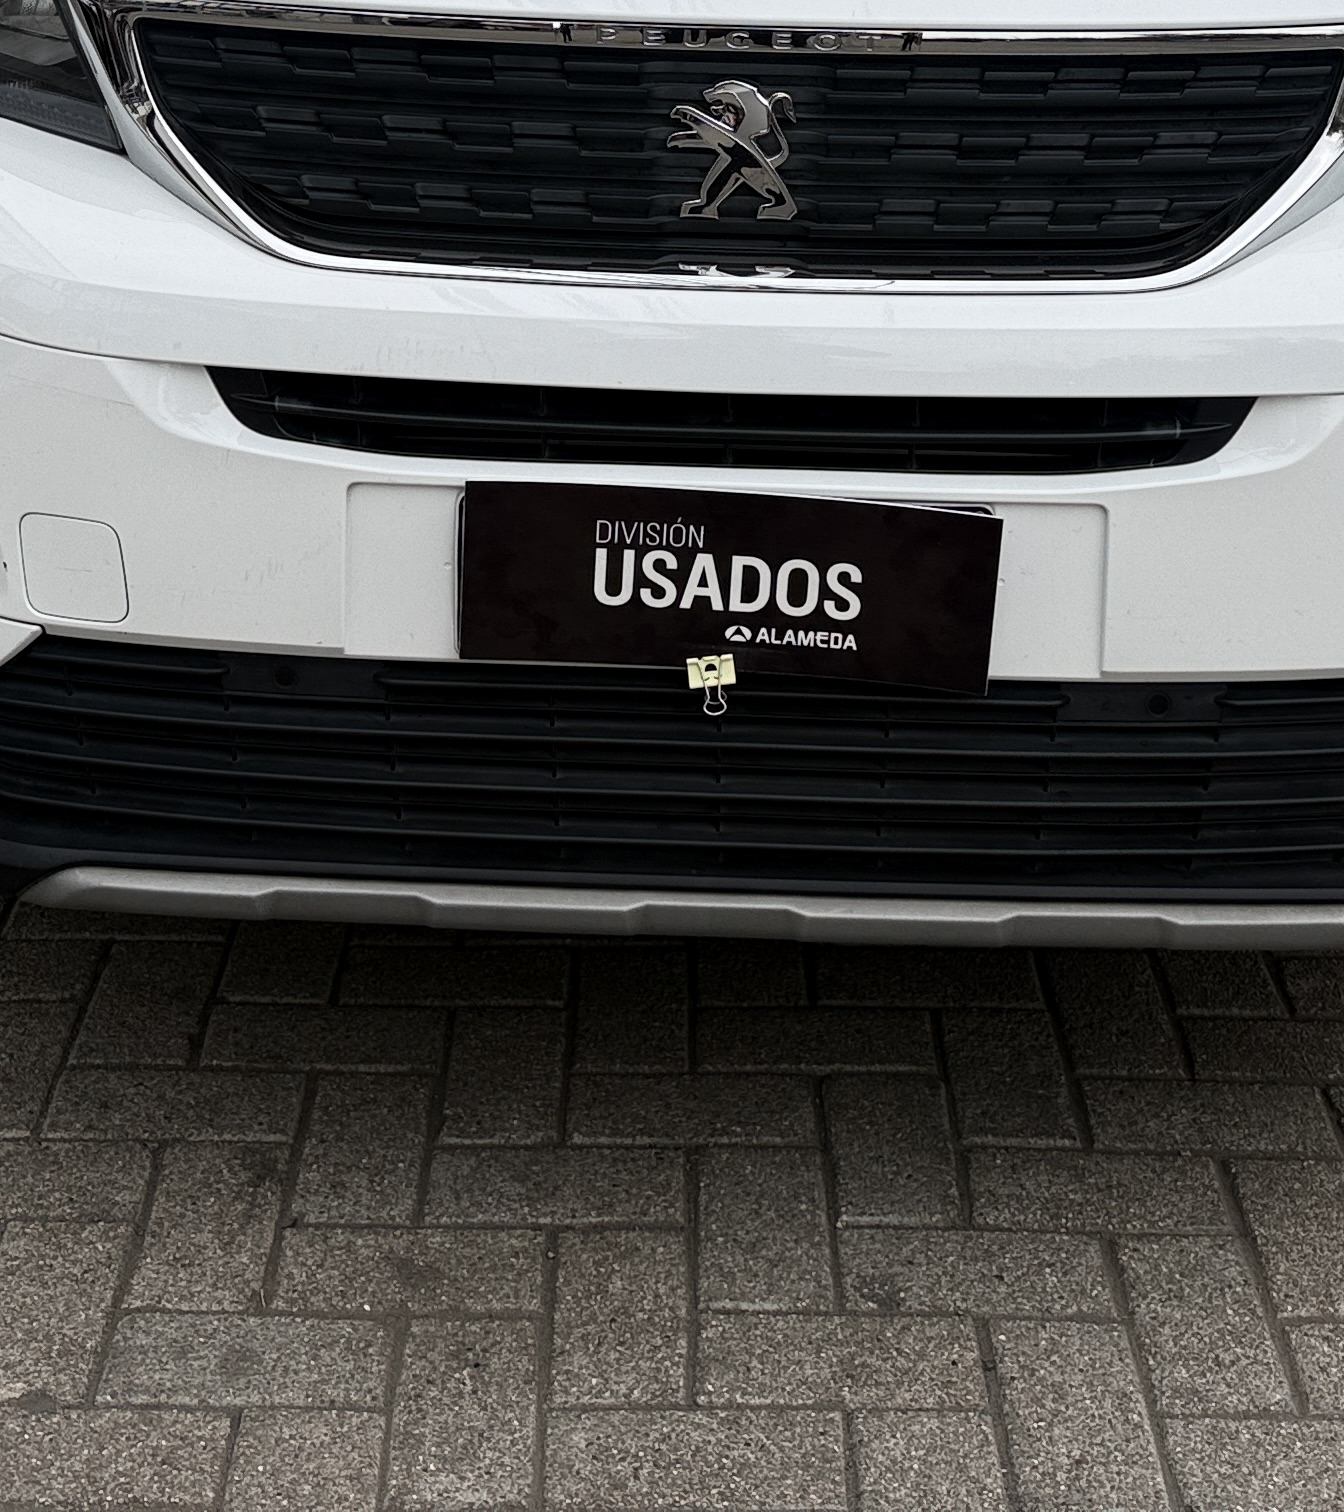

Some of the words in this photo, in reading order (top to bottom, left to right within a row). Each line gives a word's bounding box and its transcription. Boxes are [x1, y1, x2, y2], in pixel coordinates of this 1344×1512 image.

[596, 26, 882, 53] PEUGEOT
[595, 517, 705, 549] DIVISIÓN
[594, 547, 863, 621] USADOS
[755, 627, 858, 651] ALAMEDA
